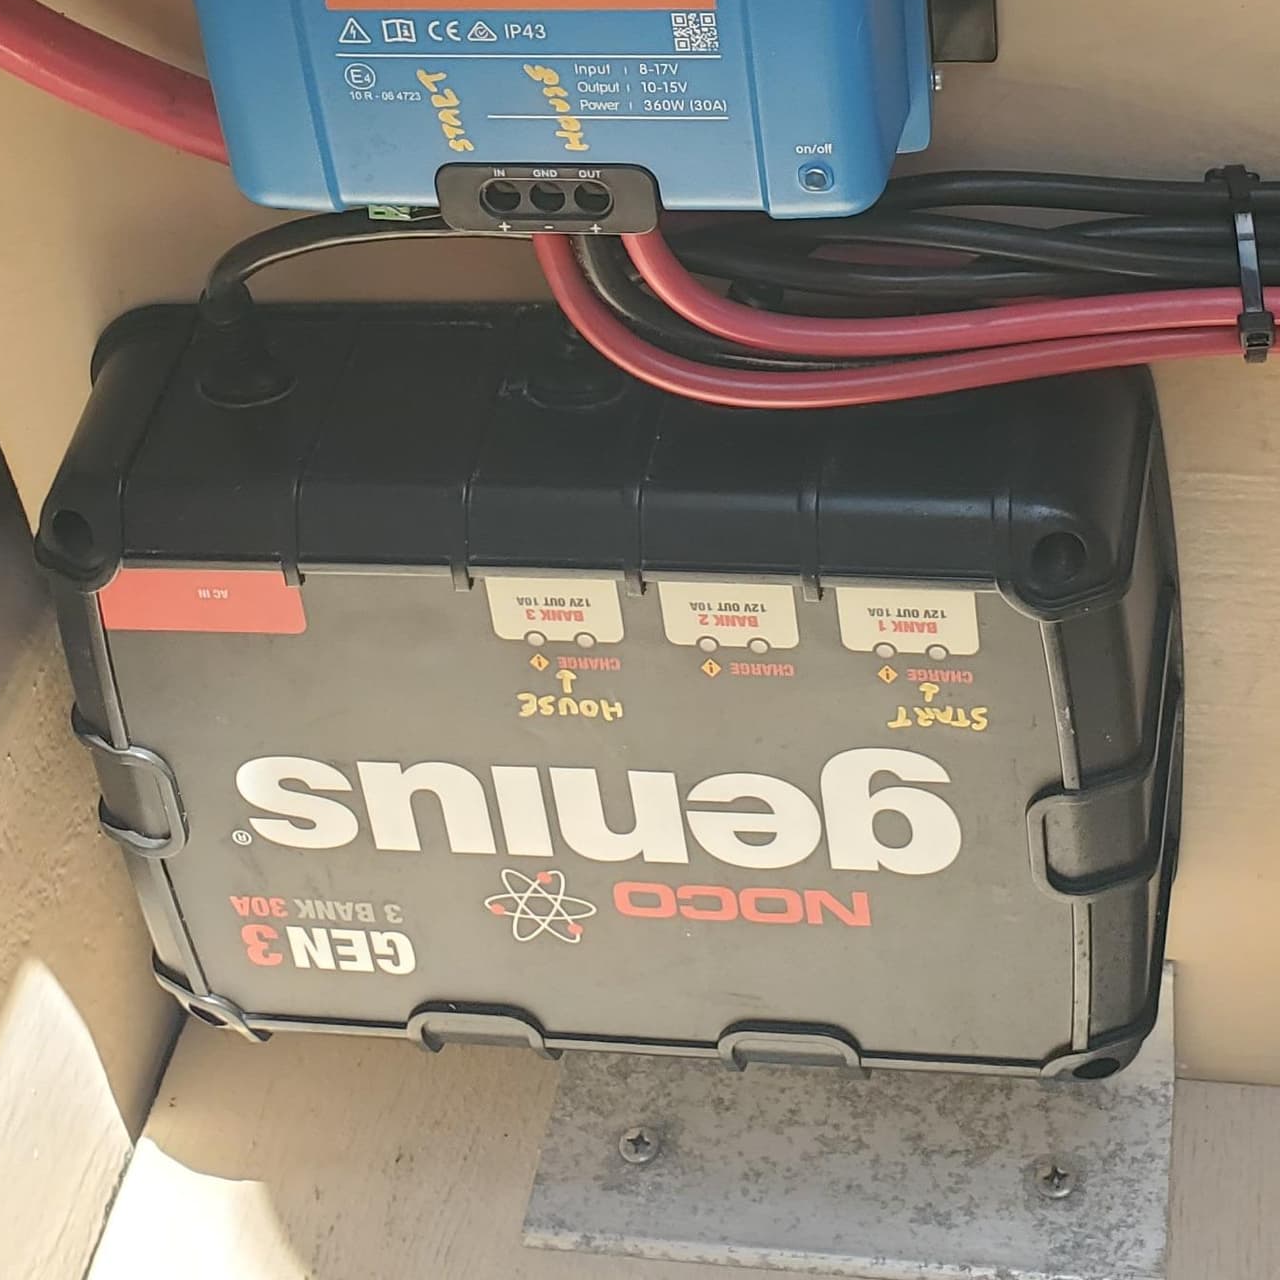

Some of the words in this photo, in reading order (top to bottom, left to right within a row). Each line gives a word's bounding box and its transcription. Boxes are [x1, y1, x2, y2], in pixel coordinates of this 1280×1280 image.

[504, 23, 547, 40] IP43
[574, 63, 611, 77] Input
[639, 64, 678, 74] 8-17V
[577, 81, 620, 95] Output
[641, 82, 688, 93] 10-15V
[580, 100, 619, 111] Power
[644, 100, 685, 111] 360W
[689, 100, 727, 112] (30A)
[796, 143, 832, 154] on/off
[493, 168, 506, 177] IN
[532, 169, 558, 178] GND
[578, 170, 601, 178] OUT
[198, 588, 210, 599] IN
[213, 589, 228, 599] AC
[516, 596, 538, 606] 10A
[542, 597, 566, 606] OUT
[569, 597, 591, 607] 12V
[689, 601, 713, 611] 10A
[717, 602, 740, 612] OUT
[743, 602, 767, 613] 12V
[525, 608, 536, 621] 3
[539, 609, 584, 622] BANK
[867, 607, 890, 617] 10A
[895, 608, 920, 618] OUT
[923, 608, 947, 619] 12V
[697, 613, 710, 626] 2
[715, 614, 759, 628] BANK
[878, 619, 887, 632] 1
[890, 620, 938, 634] BANK
[556, 656, 621, 671] CHARGE
[730, 662, 795, 677] CHARGE
[906, 667, 973, 684] CHARGE
[517, 693, 623, 721] HOUSE
[887, 705, 988, 730] START
[228, 895, 289, 918] 30A
[293, 898, 376, 923] BANK
[614, 882, 872, 927] NOCO
[383, 903, 403, 924] 3
[240, 923, 284, 967] 3
[285, 926, 416, 975] GEN
